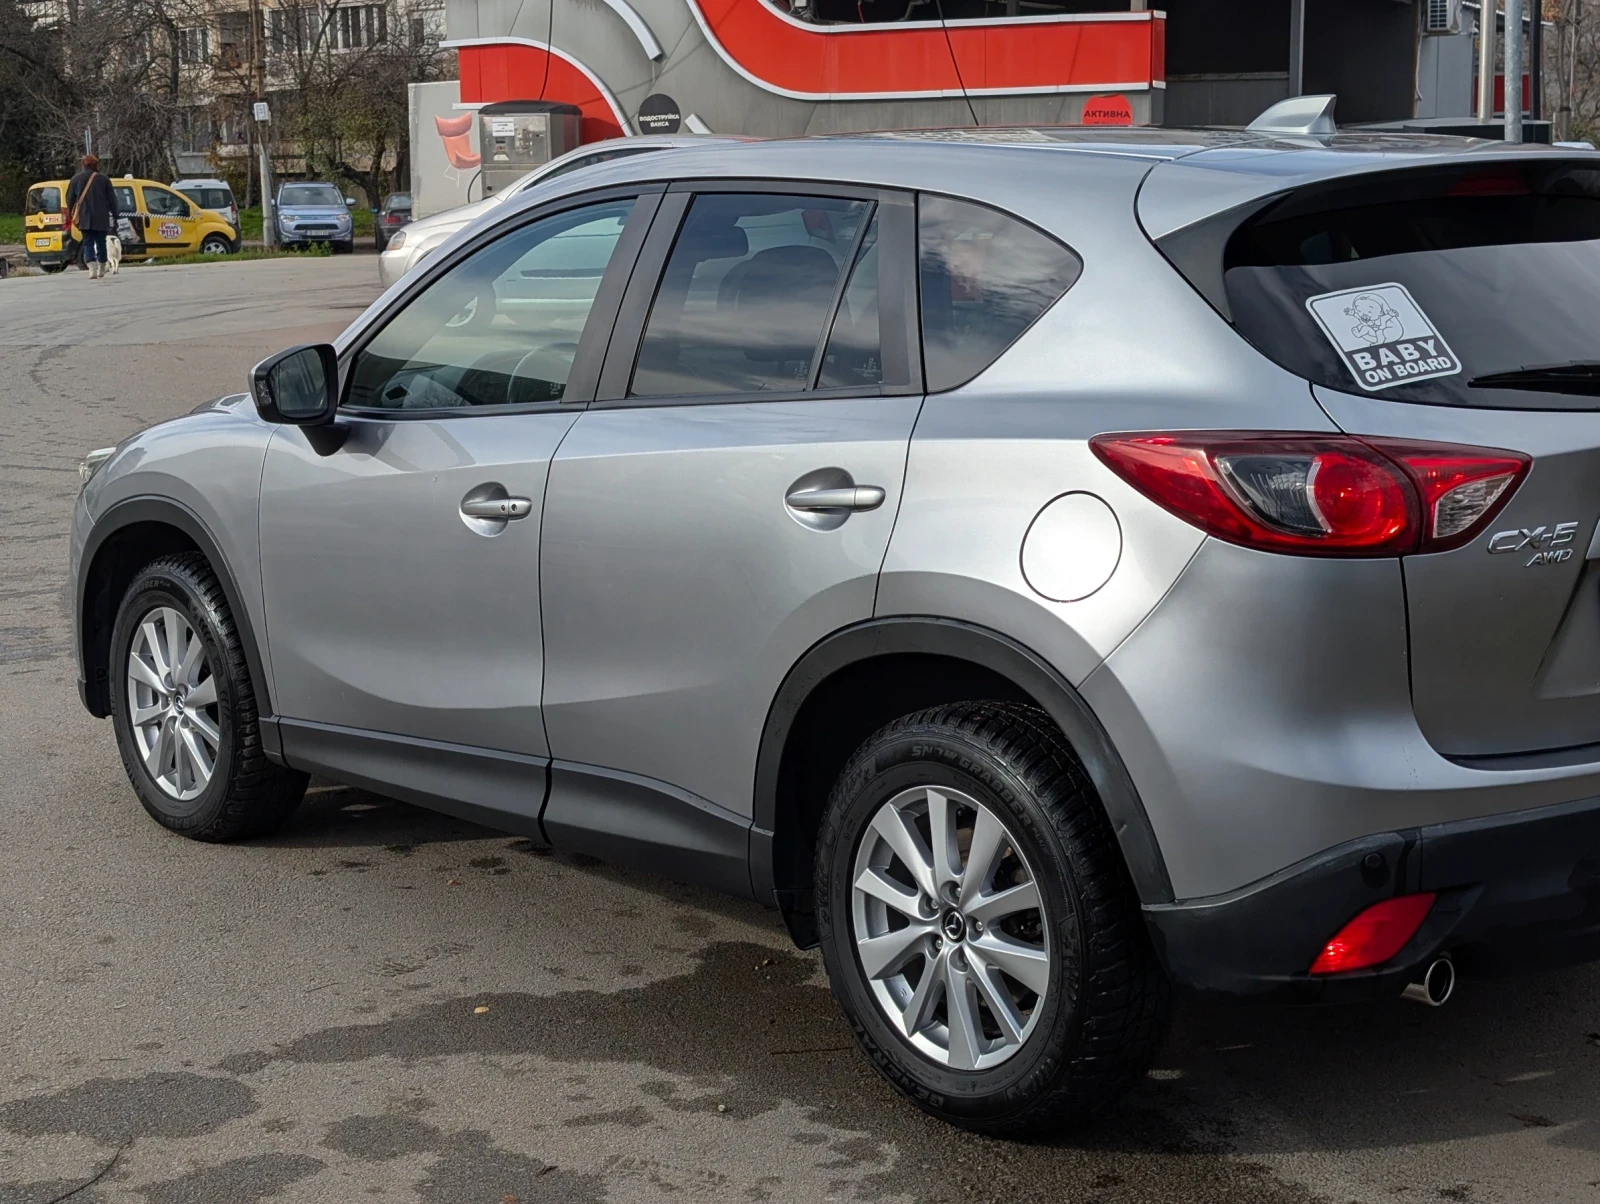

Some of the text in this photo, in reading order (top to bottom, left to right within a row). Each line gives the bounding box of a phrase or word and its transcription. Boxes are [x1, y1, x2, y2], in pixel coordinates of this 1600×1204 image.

[1084, 110, 1131, 118] АКТИВНА
[1352, 339, 1438, 371] BABY
[1365, 356, 1451, 383] ON BOARD
[1487, 521, 1579, 554] CX-5
[1524, 548, 1573, 568] AWD
